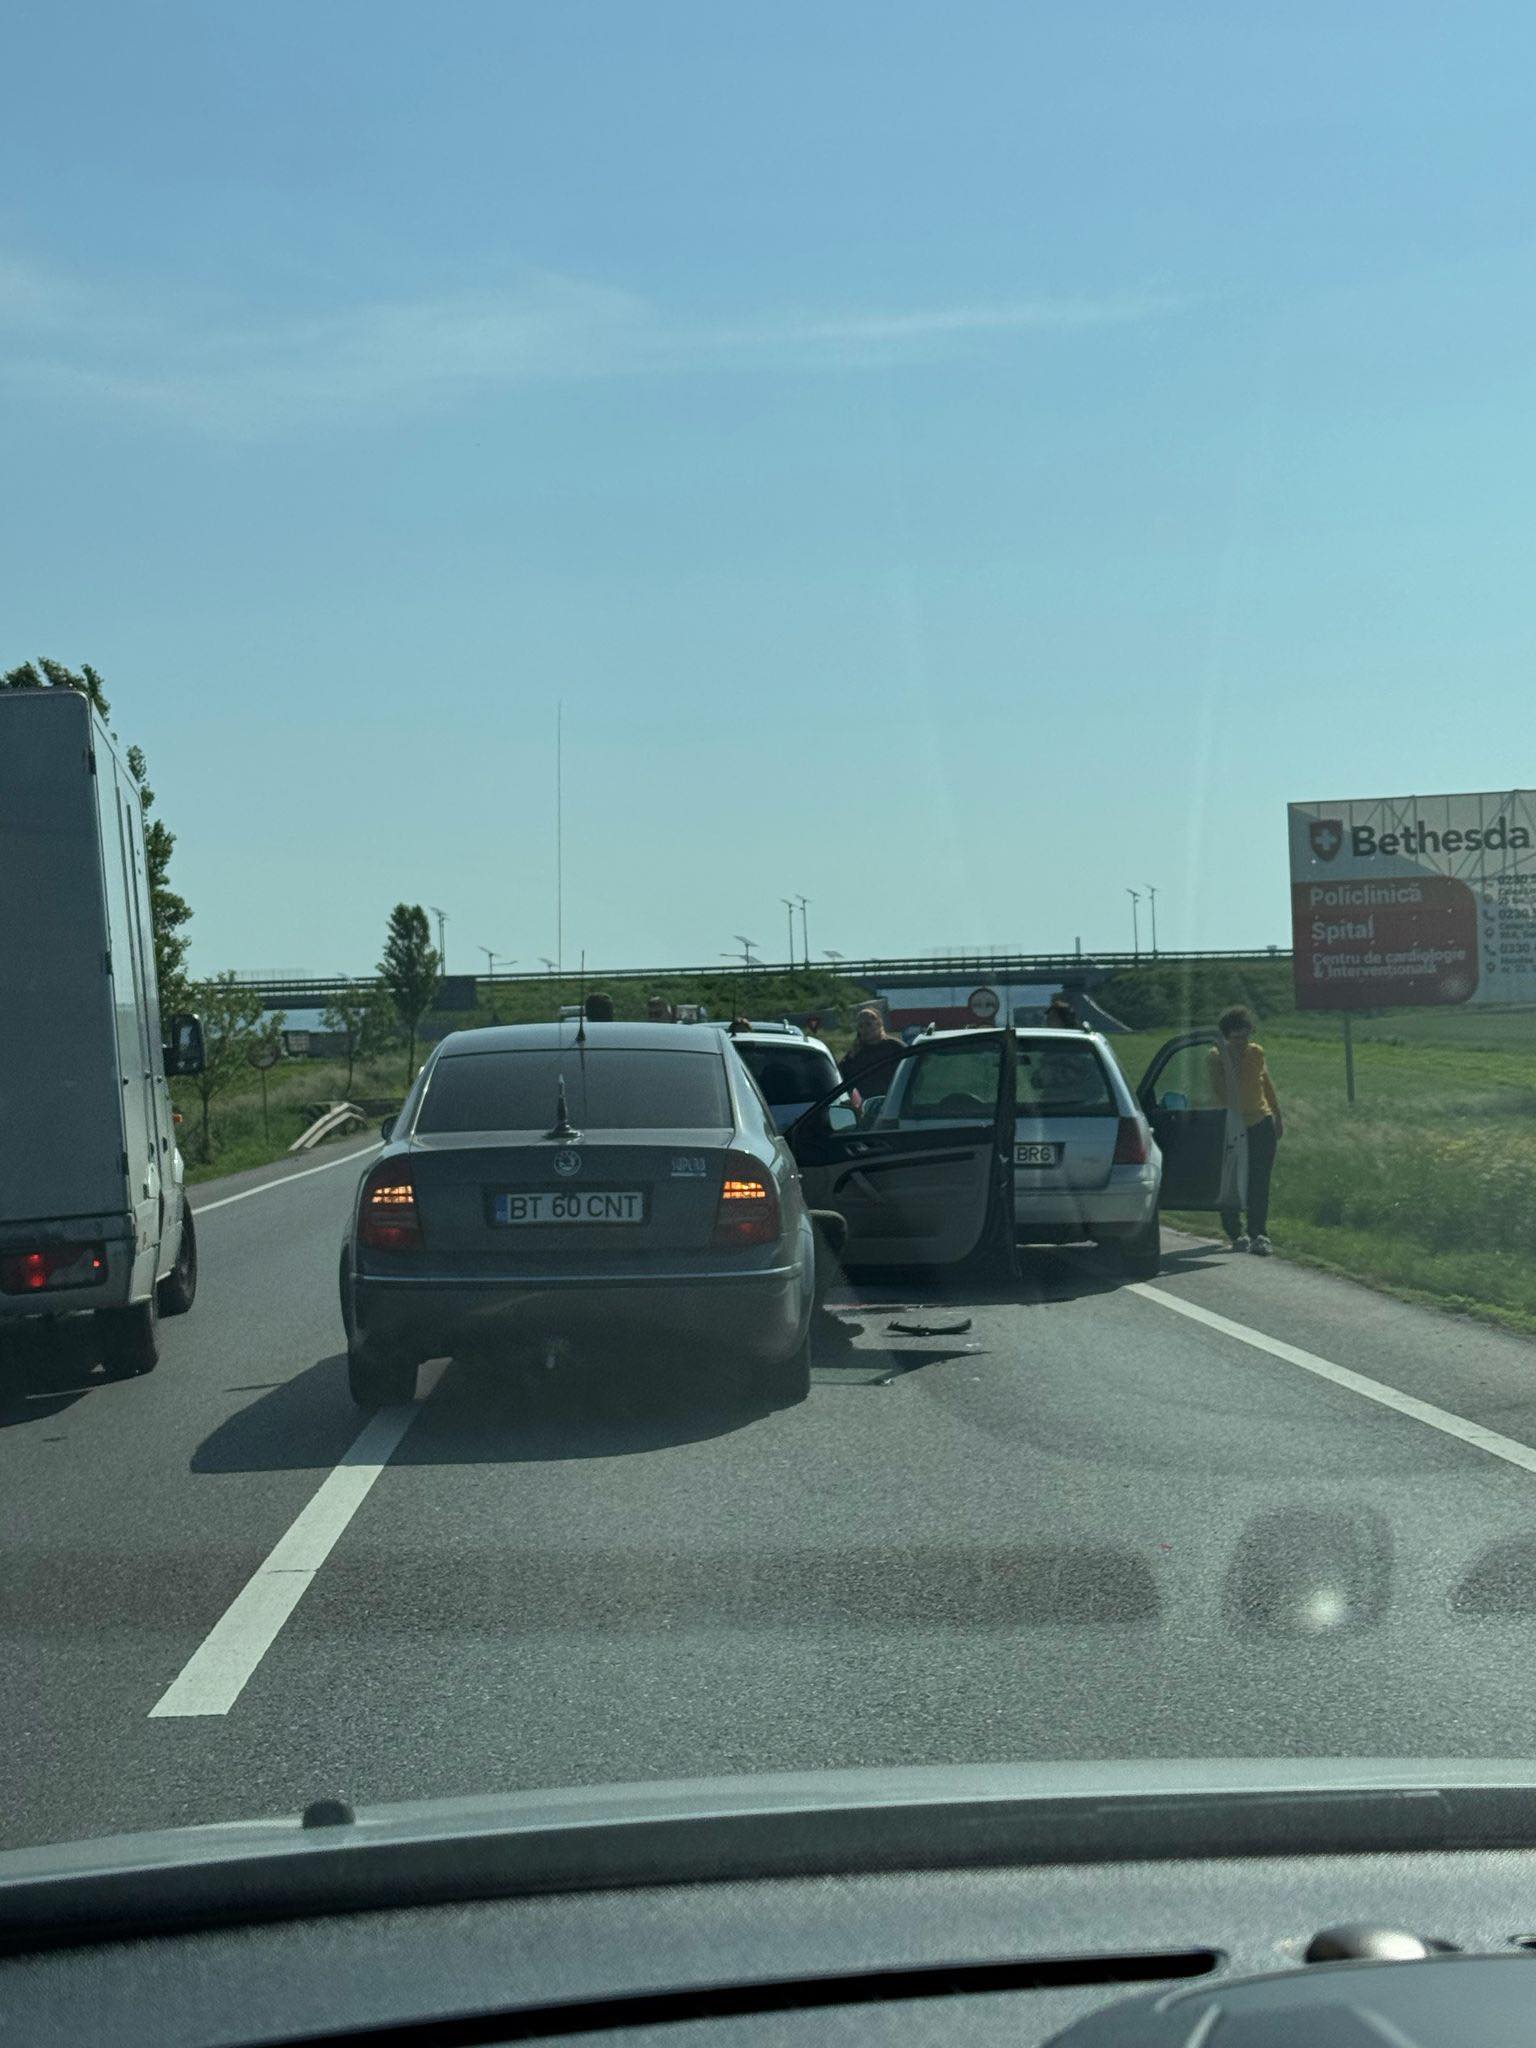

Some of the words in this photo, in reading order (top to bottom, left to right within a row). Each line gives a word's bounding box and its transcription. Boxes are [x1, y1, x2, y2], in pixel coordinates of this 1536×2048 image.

[1351, 816, 1530, 857] Bethesda
[1309, 884, 1422, 905] Policlinică
[1311, 916, 1375, 944] Spital
[1312, 952, 1360, 966] Centru
[1363, 951, 1382, 964] de
[1016, 1146, 1052, 1161] BRG
[510, 1196, 542, 1219] BT
[551, 1195, 581, 1218] 60
[587, 1194, 638, 1218] CNT
